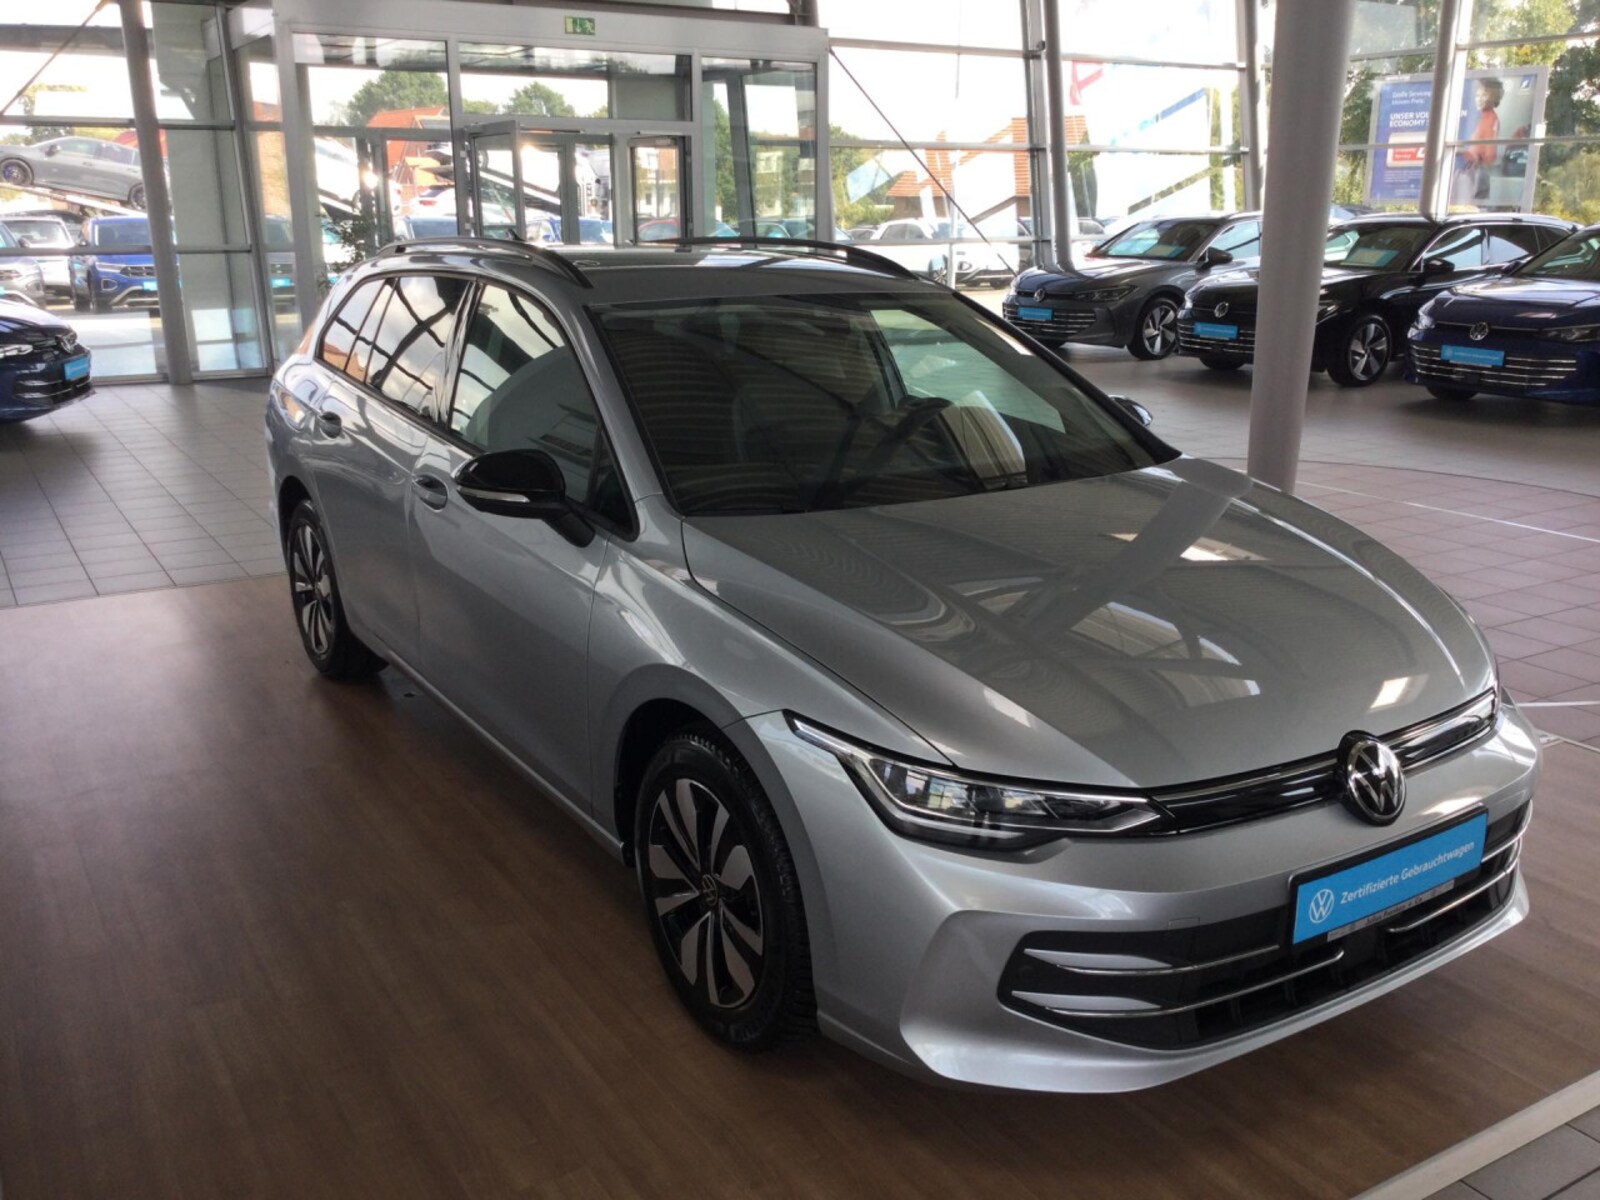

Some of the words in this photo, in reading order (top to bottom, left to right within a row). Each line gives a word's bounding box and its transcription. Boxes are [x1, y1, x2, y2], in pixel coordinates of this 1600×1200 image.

[1390, 111, 1415, 120] UNSER
[1389, 119, 1426, 128] ECONOMY
[1340, 872, 1399, 904] Zertifizierte
[1401, 841, 1475, 881] Gebrauchtwagen
